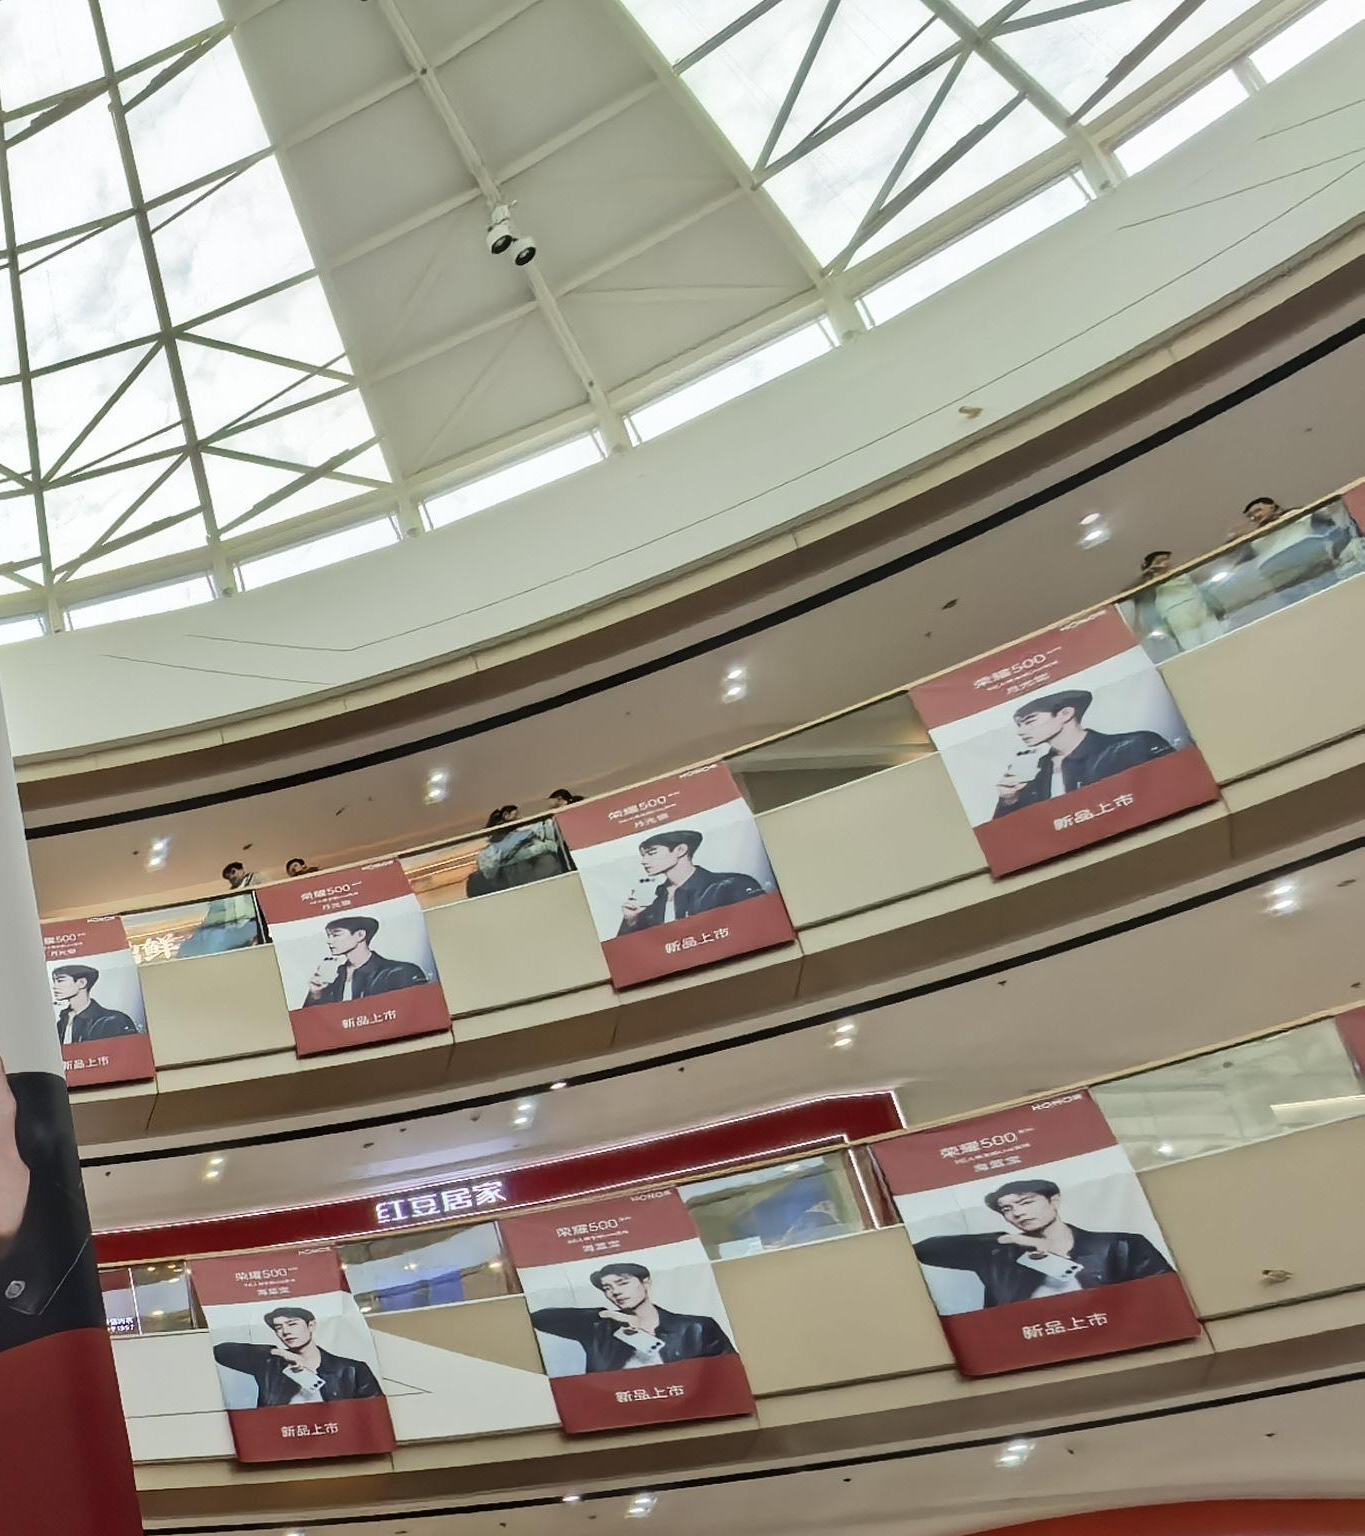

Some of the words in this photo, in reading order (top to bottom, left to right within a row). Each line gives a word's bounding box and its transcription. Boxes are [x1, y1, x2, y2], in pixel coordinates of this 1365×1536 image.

[1054, 792, 1134, 831] 新品上市
[665, 928, 729, 954] 新品上市
[342, 1010, 396, 1028] 新品上市
[375, 1180, 507, 1224] 红豆居家
[1022, 1313, 1108, 1340] 新品上市
[615, 1385, 685, 1403] 新品上市
[281, 1423, 339, 1438] 新品上市
